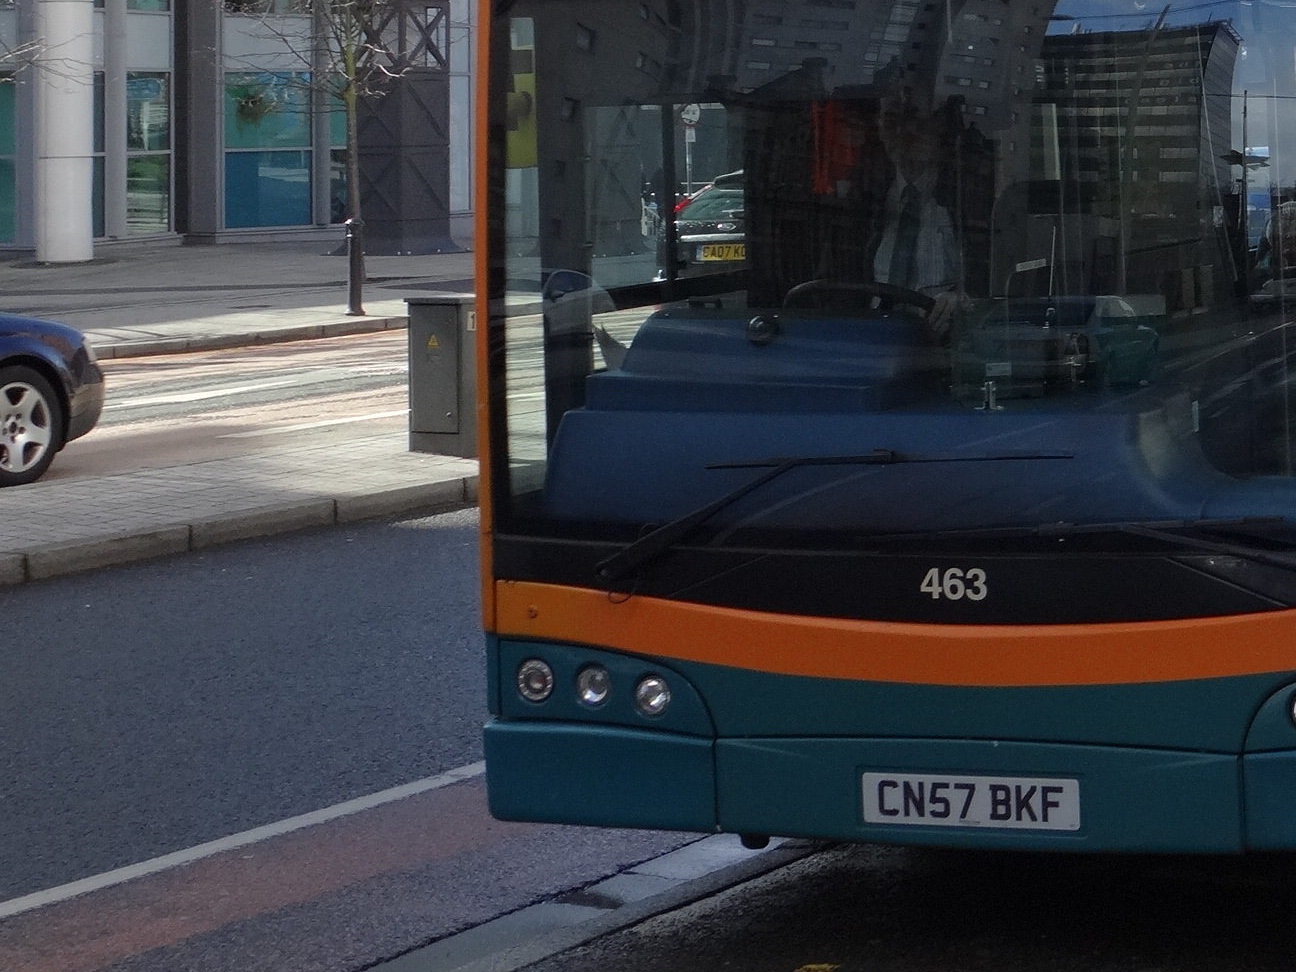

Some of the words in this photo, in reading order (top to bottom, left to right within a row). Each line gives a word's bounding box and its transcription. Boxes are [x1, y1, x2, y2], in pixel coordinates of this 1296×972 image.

[920, 567, 988, 601] 463
[877, 780, 976, 819] CN57
[989, 784, 1064, 823] BKF
